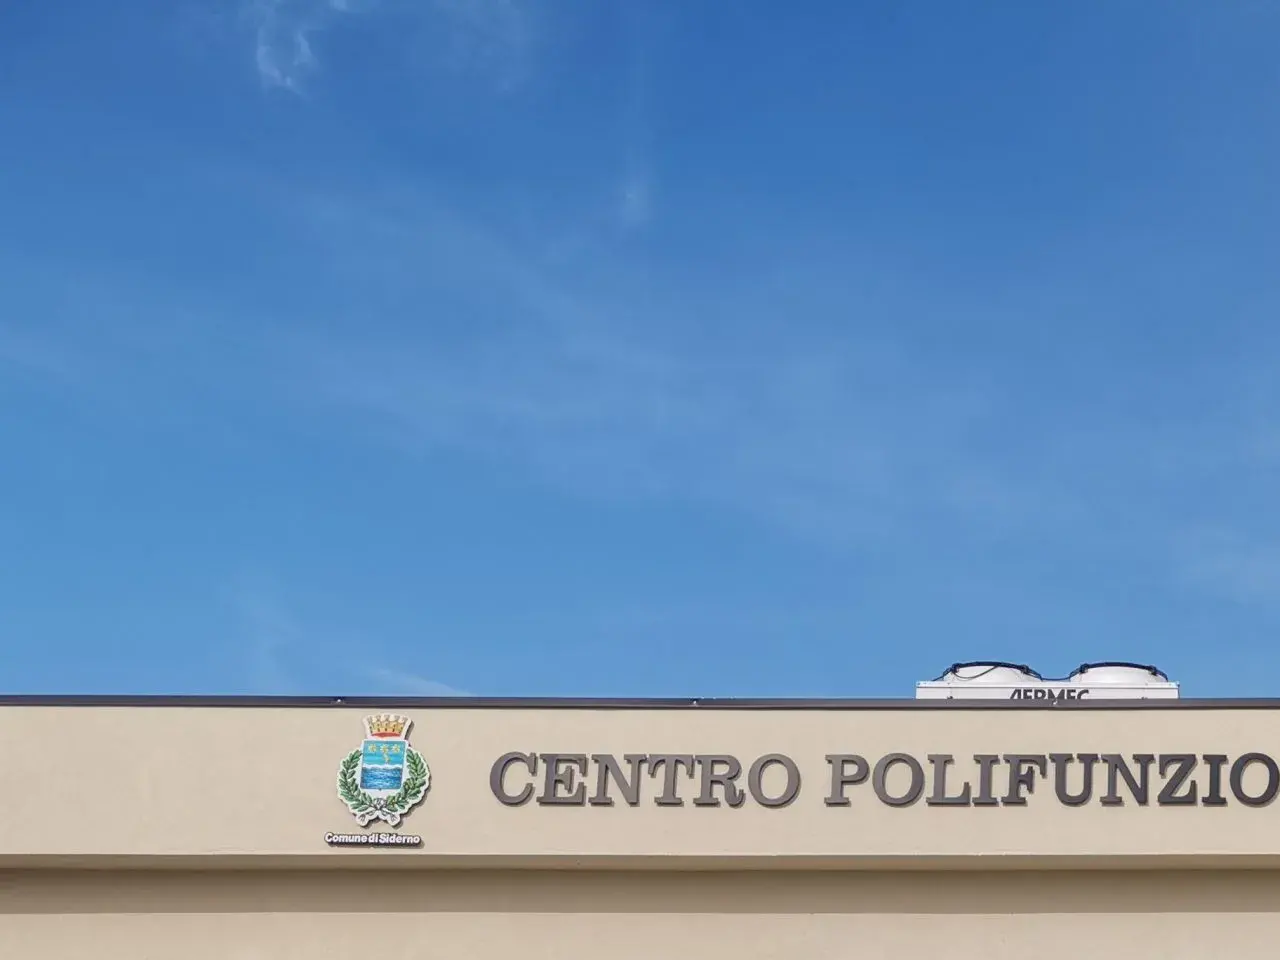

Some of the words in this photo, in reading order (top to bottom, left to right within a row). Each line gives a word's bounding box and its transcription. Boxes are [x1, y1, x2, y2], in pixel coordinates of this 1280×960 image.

[490, 751, 802, 808] CENTRO
[325, 832, 368, 844] Comune
[368, 832, 379, 844] di
[379, 832, 421, 845] Siderno
